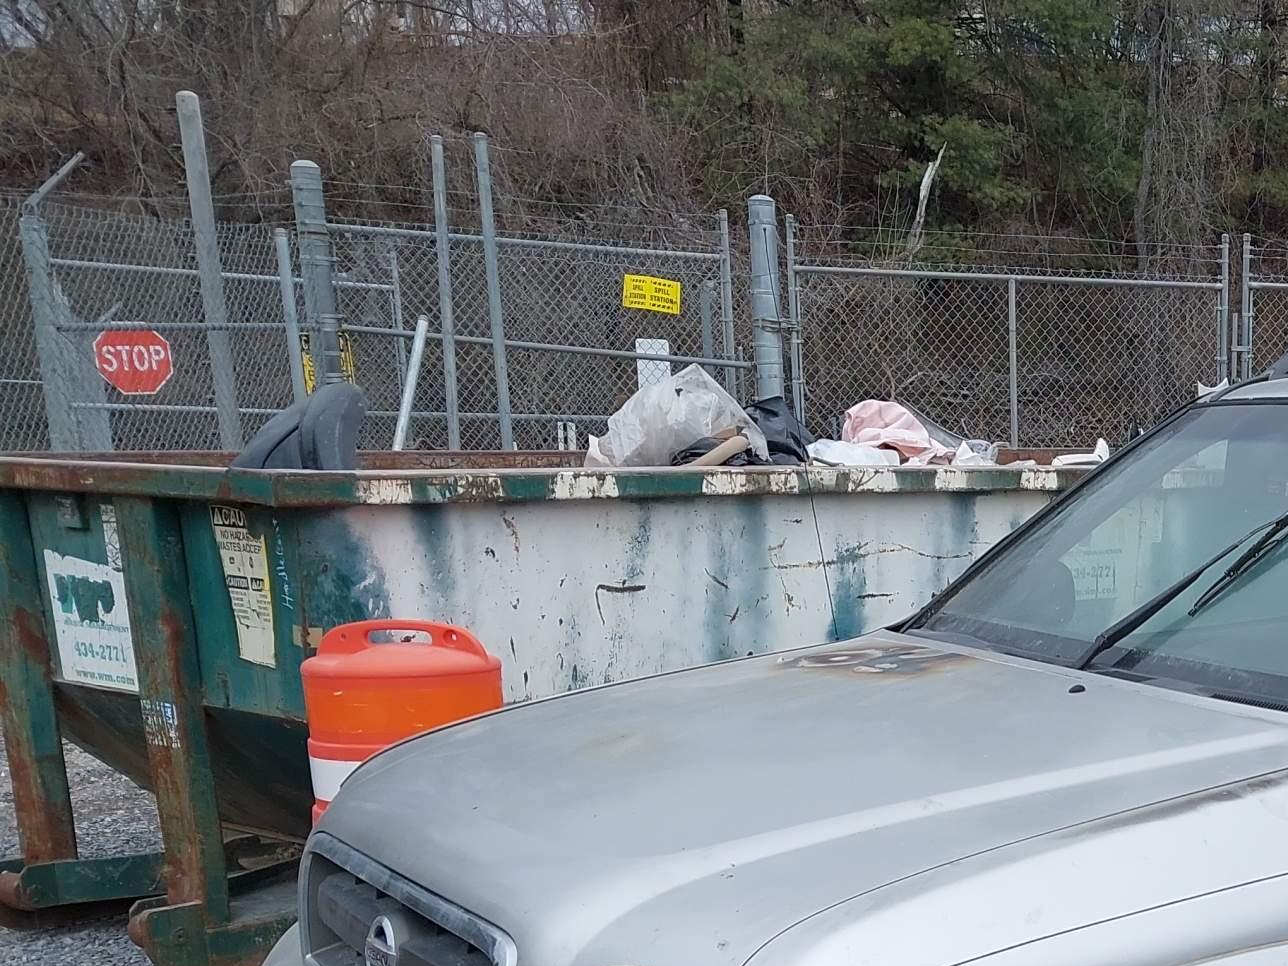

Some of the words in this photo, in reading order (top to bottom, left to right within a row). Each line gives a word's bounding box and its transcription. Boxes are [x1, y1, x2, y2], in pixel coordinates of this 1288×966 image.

[650, 294, 674, 304] STATION
[654, 287, 670, 295] SPILL
[101, 345, 165, 372] STOP
[74, 641, 127, 663] 434-2771
[75, 669, 136, 686] www.wm.com
